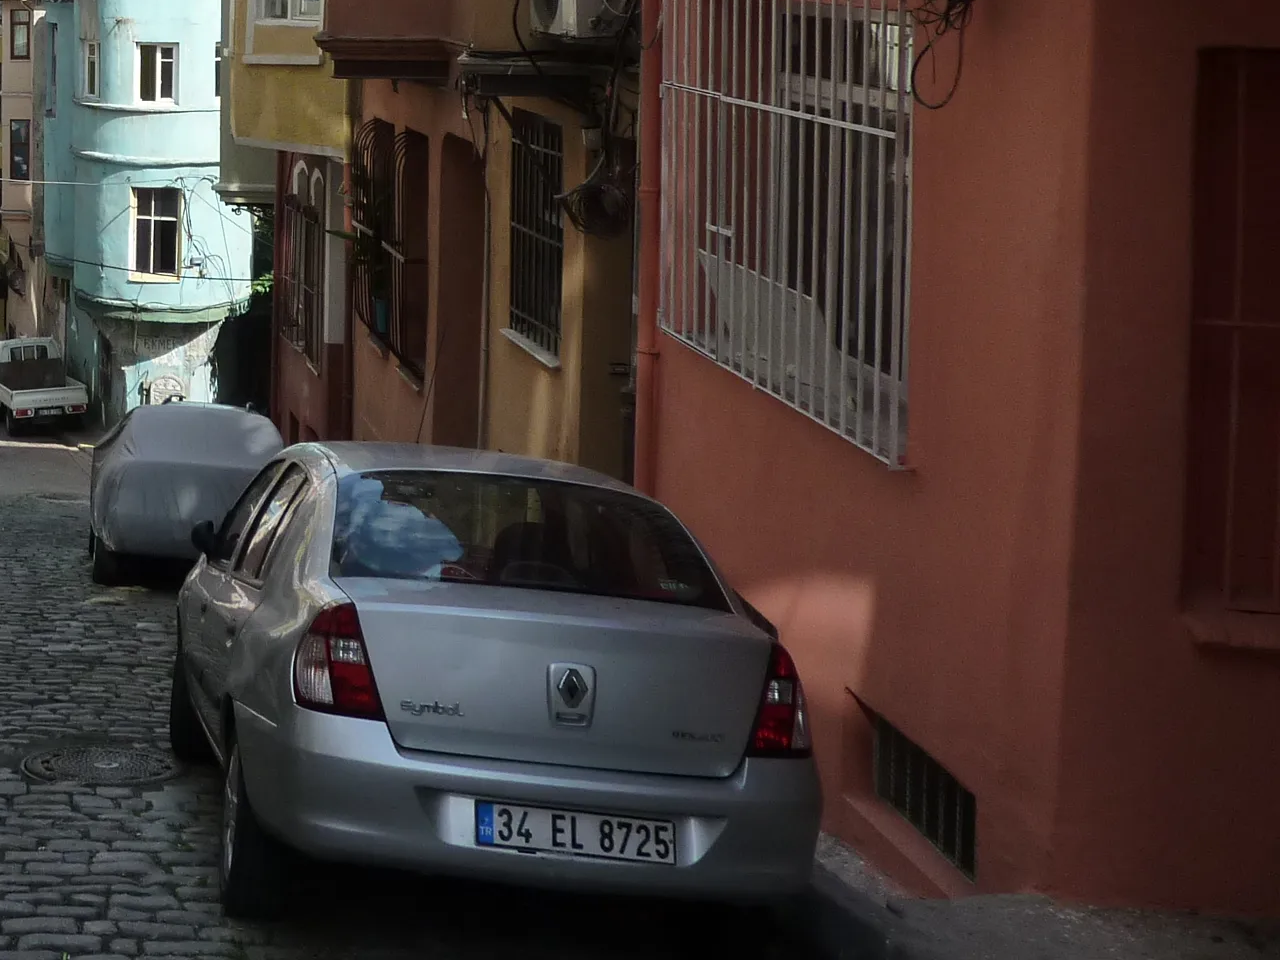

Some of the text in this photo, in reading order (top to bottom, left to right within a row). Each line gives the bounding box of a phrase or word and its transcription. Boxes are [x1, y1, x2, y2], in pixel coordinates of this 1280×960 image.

[400, 699, 465, 716] Symbol
[479, 825, 493, 836] TR
[497, 808, 670, 859] 34 EL 8725
